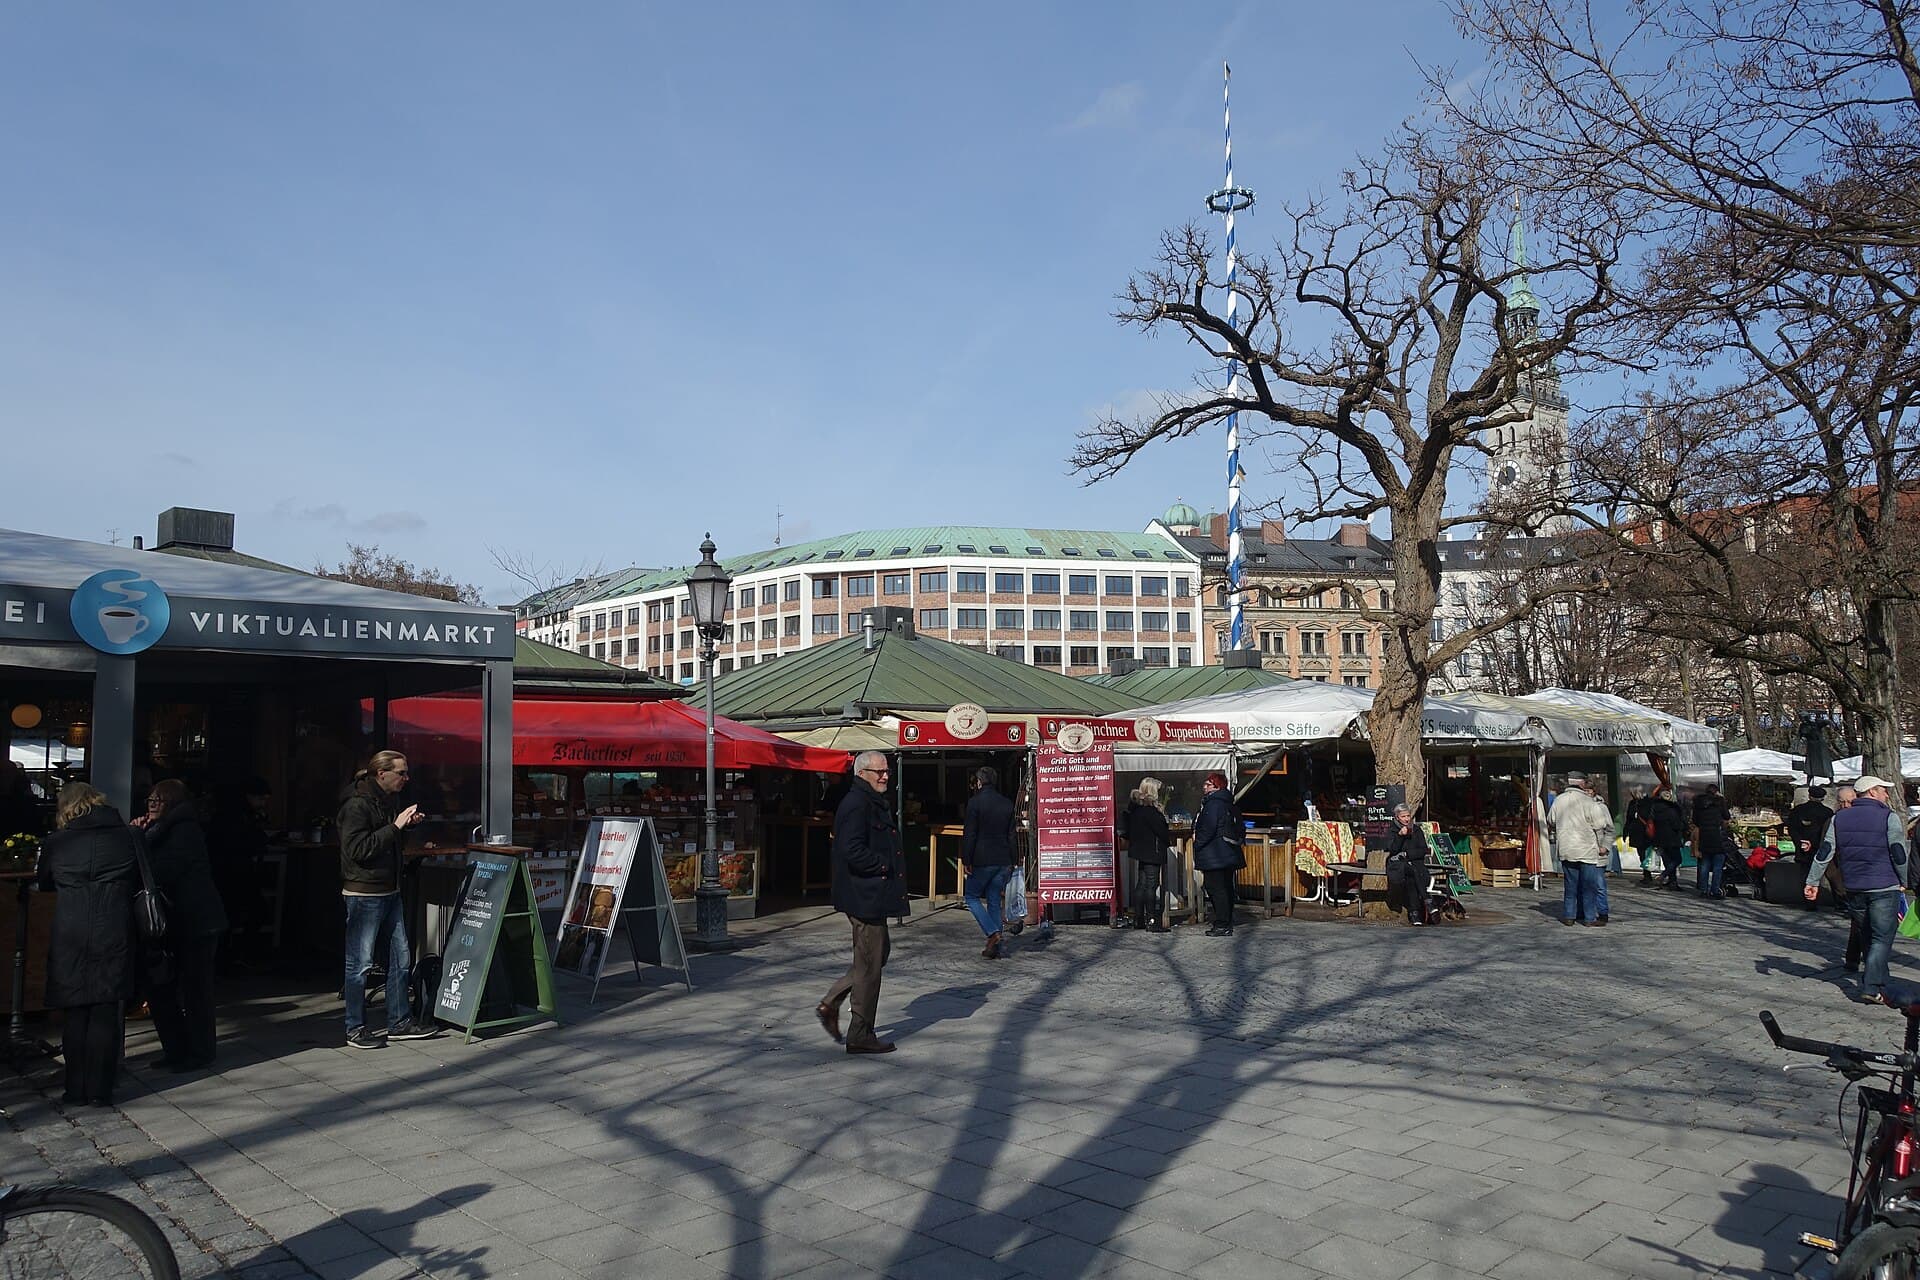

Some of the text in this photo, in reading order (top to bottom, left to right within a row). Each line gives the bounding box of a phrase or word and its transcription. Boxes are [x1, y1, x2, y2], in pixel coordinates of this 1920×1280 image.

[190, 611, 495, 645] VIKTUALIENMARKT
[1083, 721, 1225, 742] ünchner Suppenküche
[1230, 723, 1321, 740] epresste Säfte
[1039, 744, 1111, 755] Seit 1982
[644, 750, 662, 762] seit
[1051, 757, 1067, 765] Grüß
[1068, 756, 1084, 764] Gott
[1039, 764, 1112, 774] Herzlich Willkommen
[1053, 889, 1113, 901] BIERGARTEN
[484, 901, 493, 909] mit
[448, 959, 471, 977] KAFFEE
[440, 997, 460, 1011] MARKT
